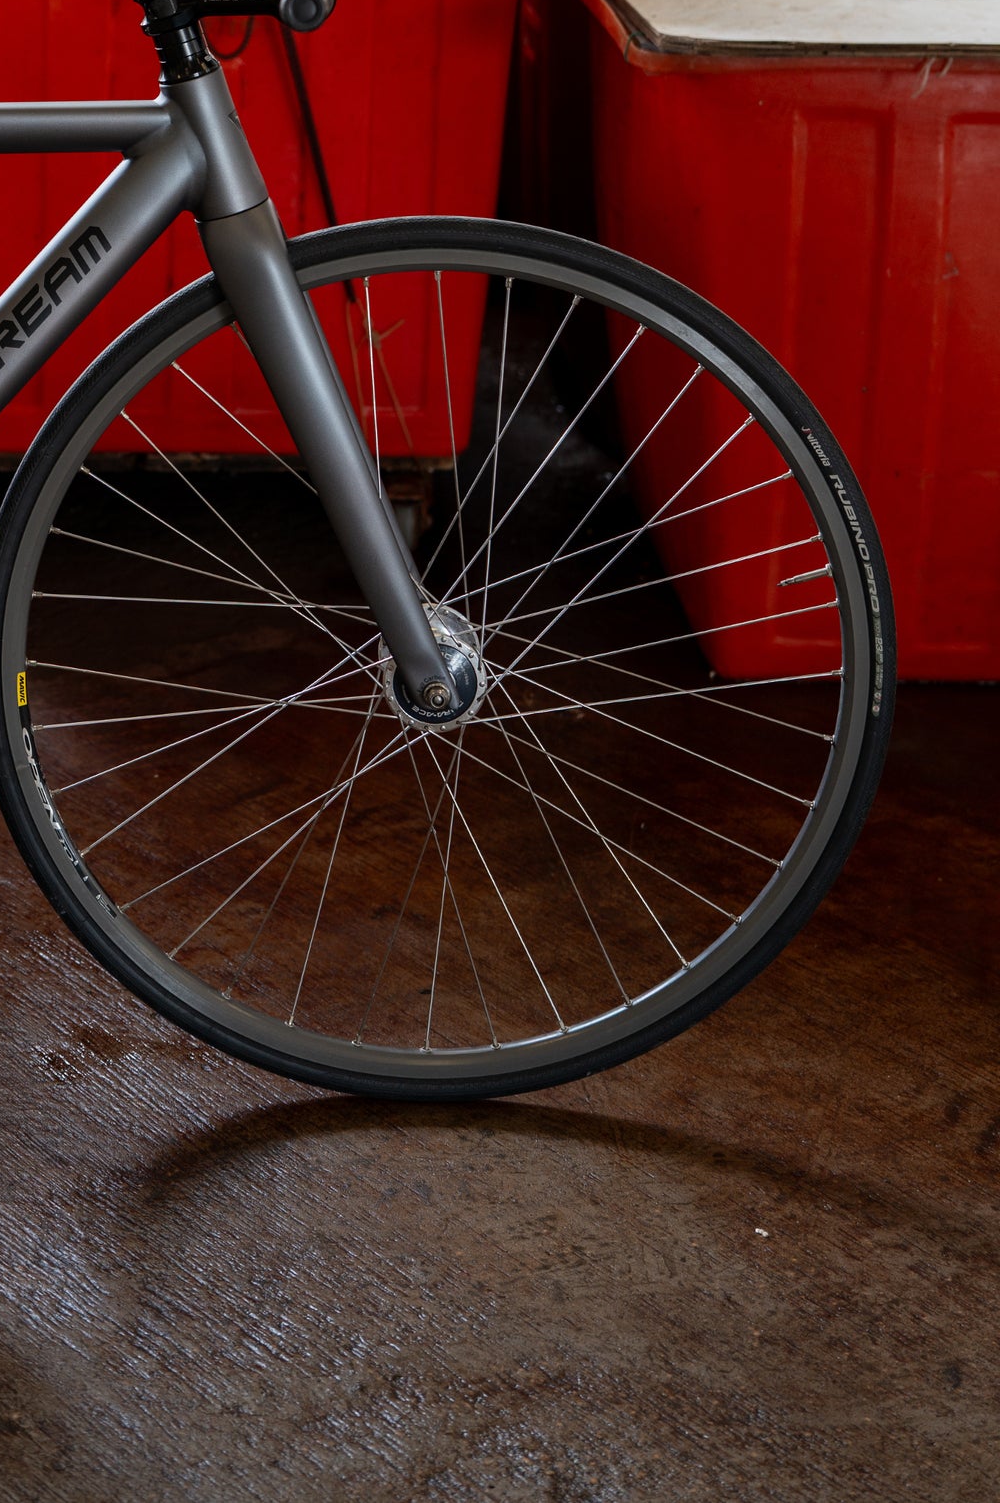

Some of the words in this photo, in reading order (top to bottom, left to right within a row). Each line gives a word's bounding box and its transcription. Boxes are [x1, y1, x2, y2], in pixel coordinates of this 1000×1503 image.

[829, 474, 869, 562] RUBINO
[864, 561, 880, 613] PRO
[18, 674, 26, 704] MAVIC
